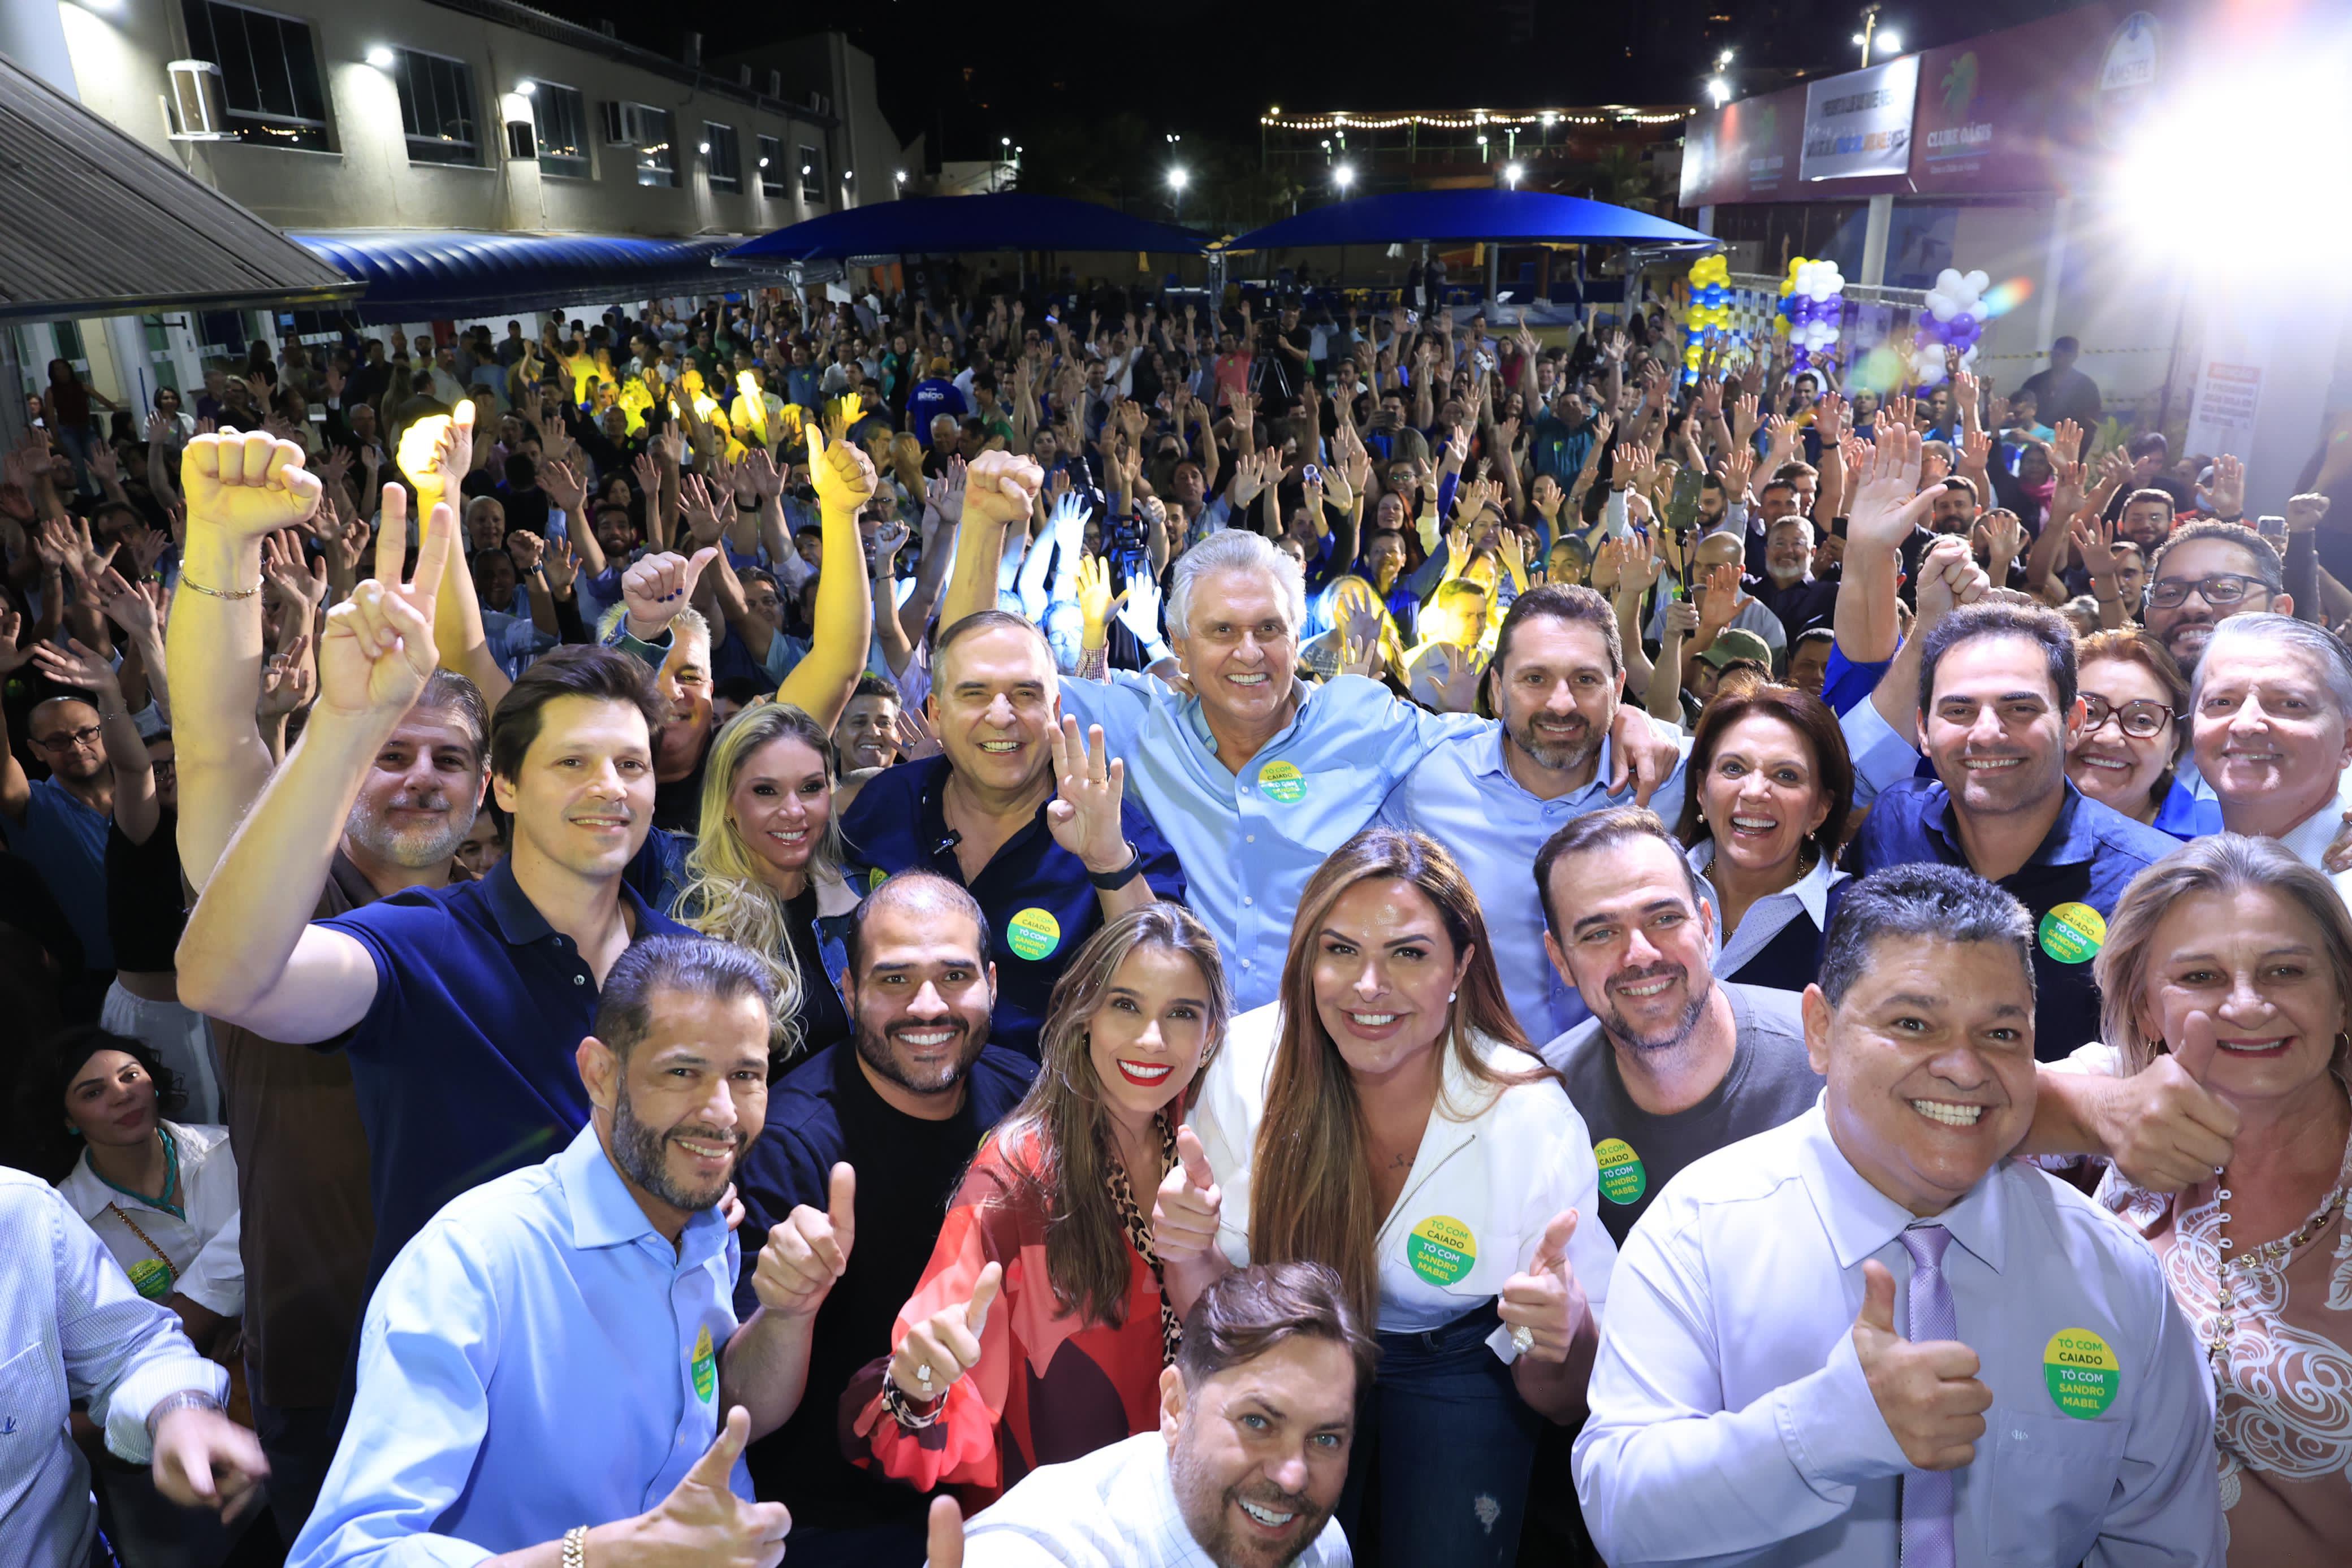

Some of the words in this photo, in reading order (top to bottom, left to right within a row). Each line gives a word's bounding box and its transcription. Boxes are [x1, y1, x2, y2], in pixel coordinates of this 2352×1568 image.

[1927, 128, 1959, 148] CLUBE
[1022, 919, 1050, 932] CAIADO
[2063, 913, 2094, 935] CAIADO
[1014, 934, 1046, 950] SANDRO
[1030, 932, 1048, 943] COM
[2047, 929, 2082, 954] SANDRO
[2066, 930, 2087, 947] COM
[1015, 942, 1040, 957] MABEL
[2044, 937, 2072, 959] MABEL
[1608, 1144, 1626, 1153] COM
[1599, 1153, 1629, 1166] CAIADO
[1603, 1168, 1614, 1179] TÔ
[1615, 1165, 1633, 1176] COM
[1605, 1175, 1638, 1188] SANDRO
[1611, 1185, 1638, 1197] MABEL
[1432, 1220, 1445, 1230] TÔ
[1446, 1227, 1468, 1240] COM
[1427, 1230, 1464, 1249] CAIADO
[1423, 1241, 1437, 1253] TÔ
[1438, 1249, 1460, 1263] COM
[1417, 1250, 1458, 1272] SANDRO
[146, 1272, 162, 1284] COM
[1417, 1261, 1450, 1281] MABEL
[2057, 1337, 2074, 1349] TÔ
[2076, 1340, 2102, 1352] COM
[2059, 1352, 2103, 1365] CAIADO
[2060, 1368, 2076, 1380] TÔ
[2078, 1372, 2103, 1384] COM
[2059, 1383, 2105, 1396] SANDRO
[2063, 1396, 2100, 1409] MABEL
